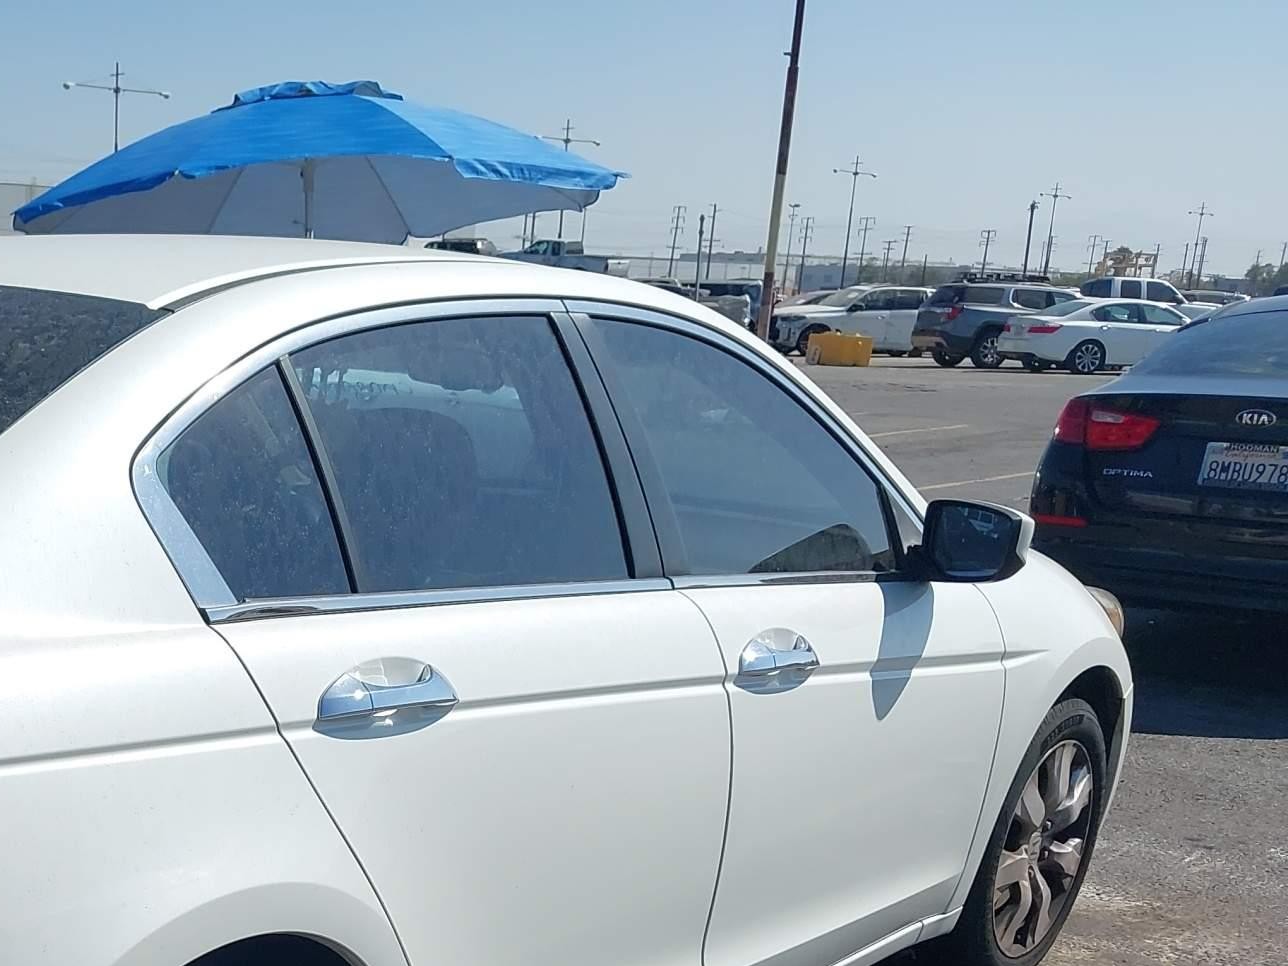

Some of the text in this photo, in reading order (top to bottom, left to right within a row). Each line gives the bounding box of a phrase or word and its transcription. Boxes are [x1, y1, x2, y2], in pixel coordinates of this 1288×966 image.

[1241, 412, 1271, 425] KIA
[1103, 468, 1153, 478] OPTIMA
[1207, 460, 1288, 483] 8MBU978
